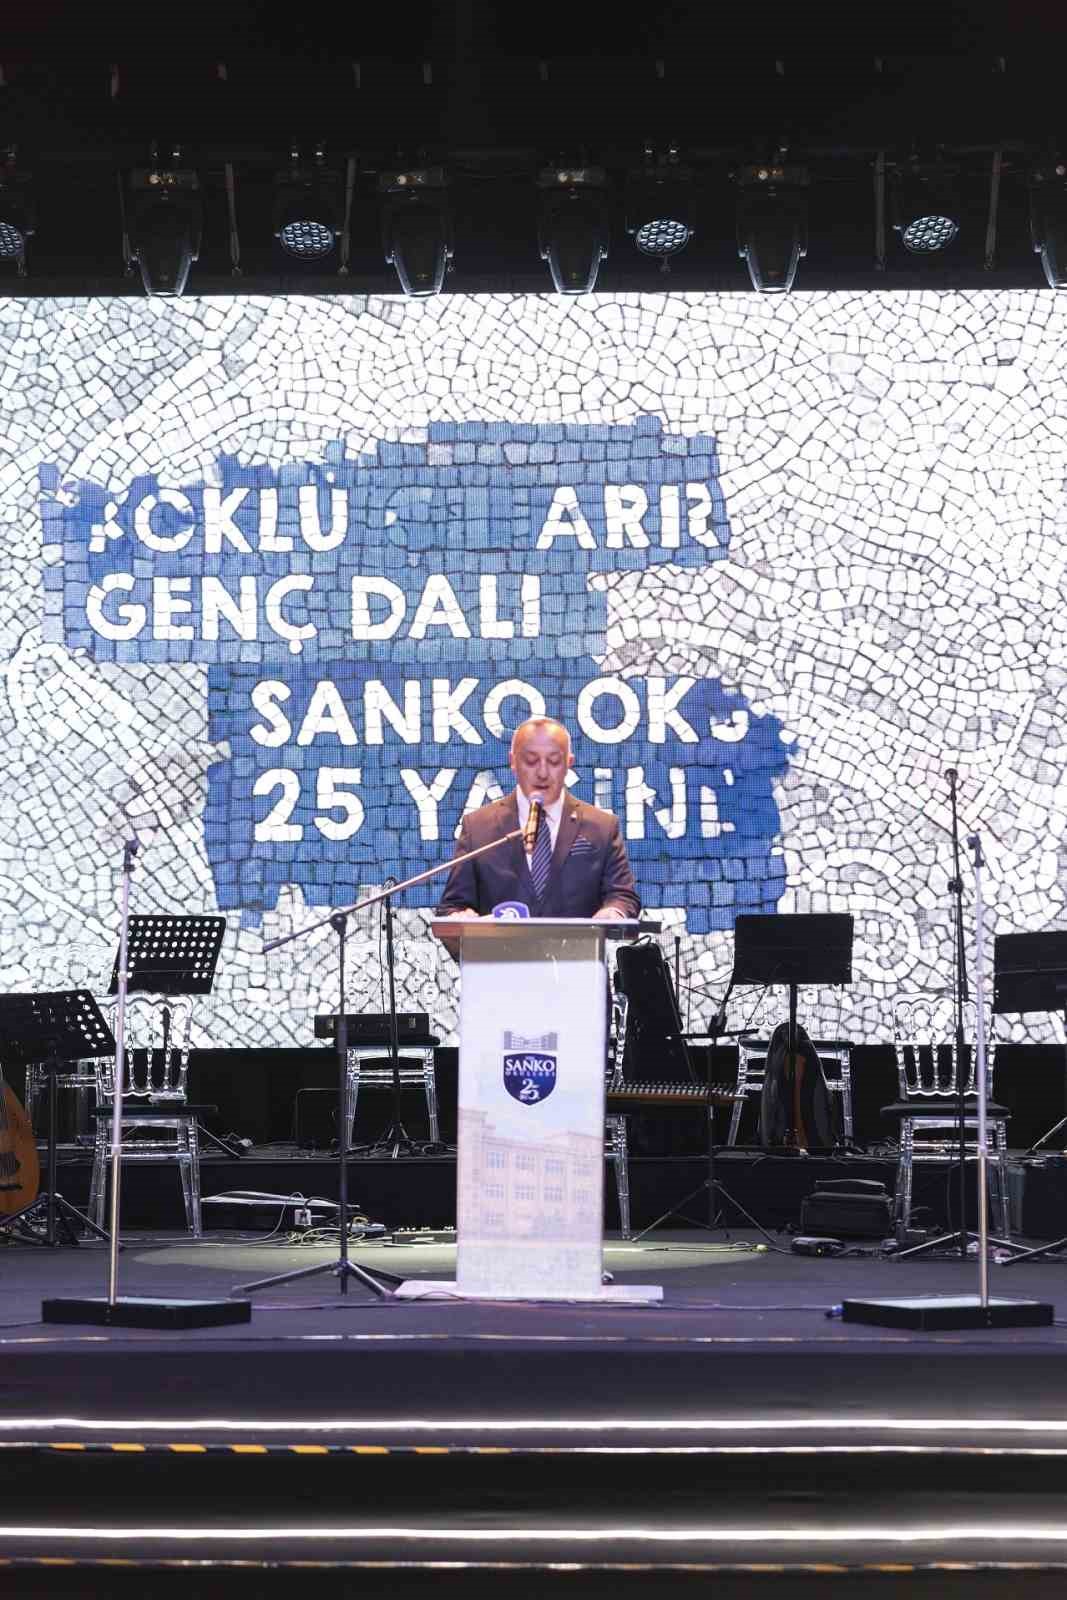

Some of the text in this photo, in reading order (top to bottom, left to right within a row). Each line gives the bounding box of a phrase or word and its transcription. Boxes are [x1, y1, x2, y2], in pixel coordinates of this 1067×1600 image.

[86, 573, 541, 654] GENÇ DALI
[249, 678, 546, 747] SANKO
[252, 767, 365, 841] 25
[505, 1059, 555, 1072] SANKO
[520, 1078, 540, 1100] 25
